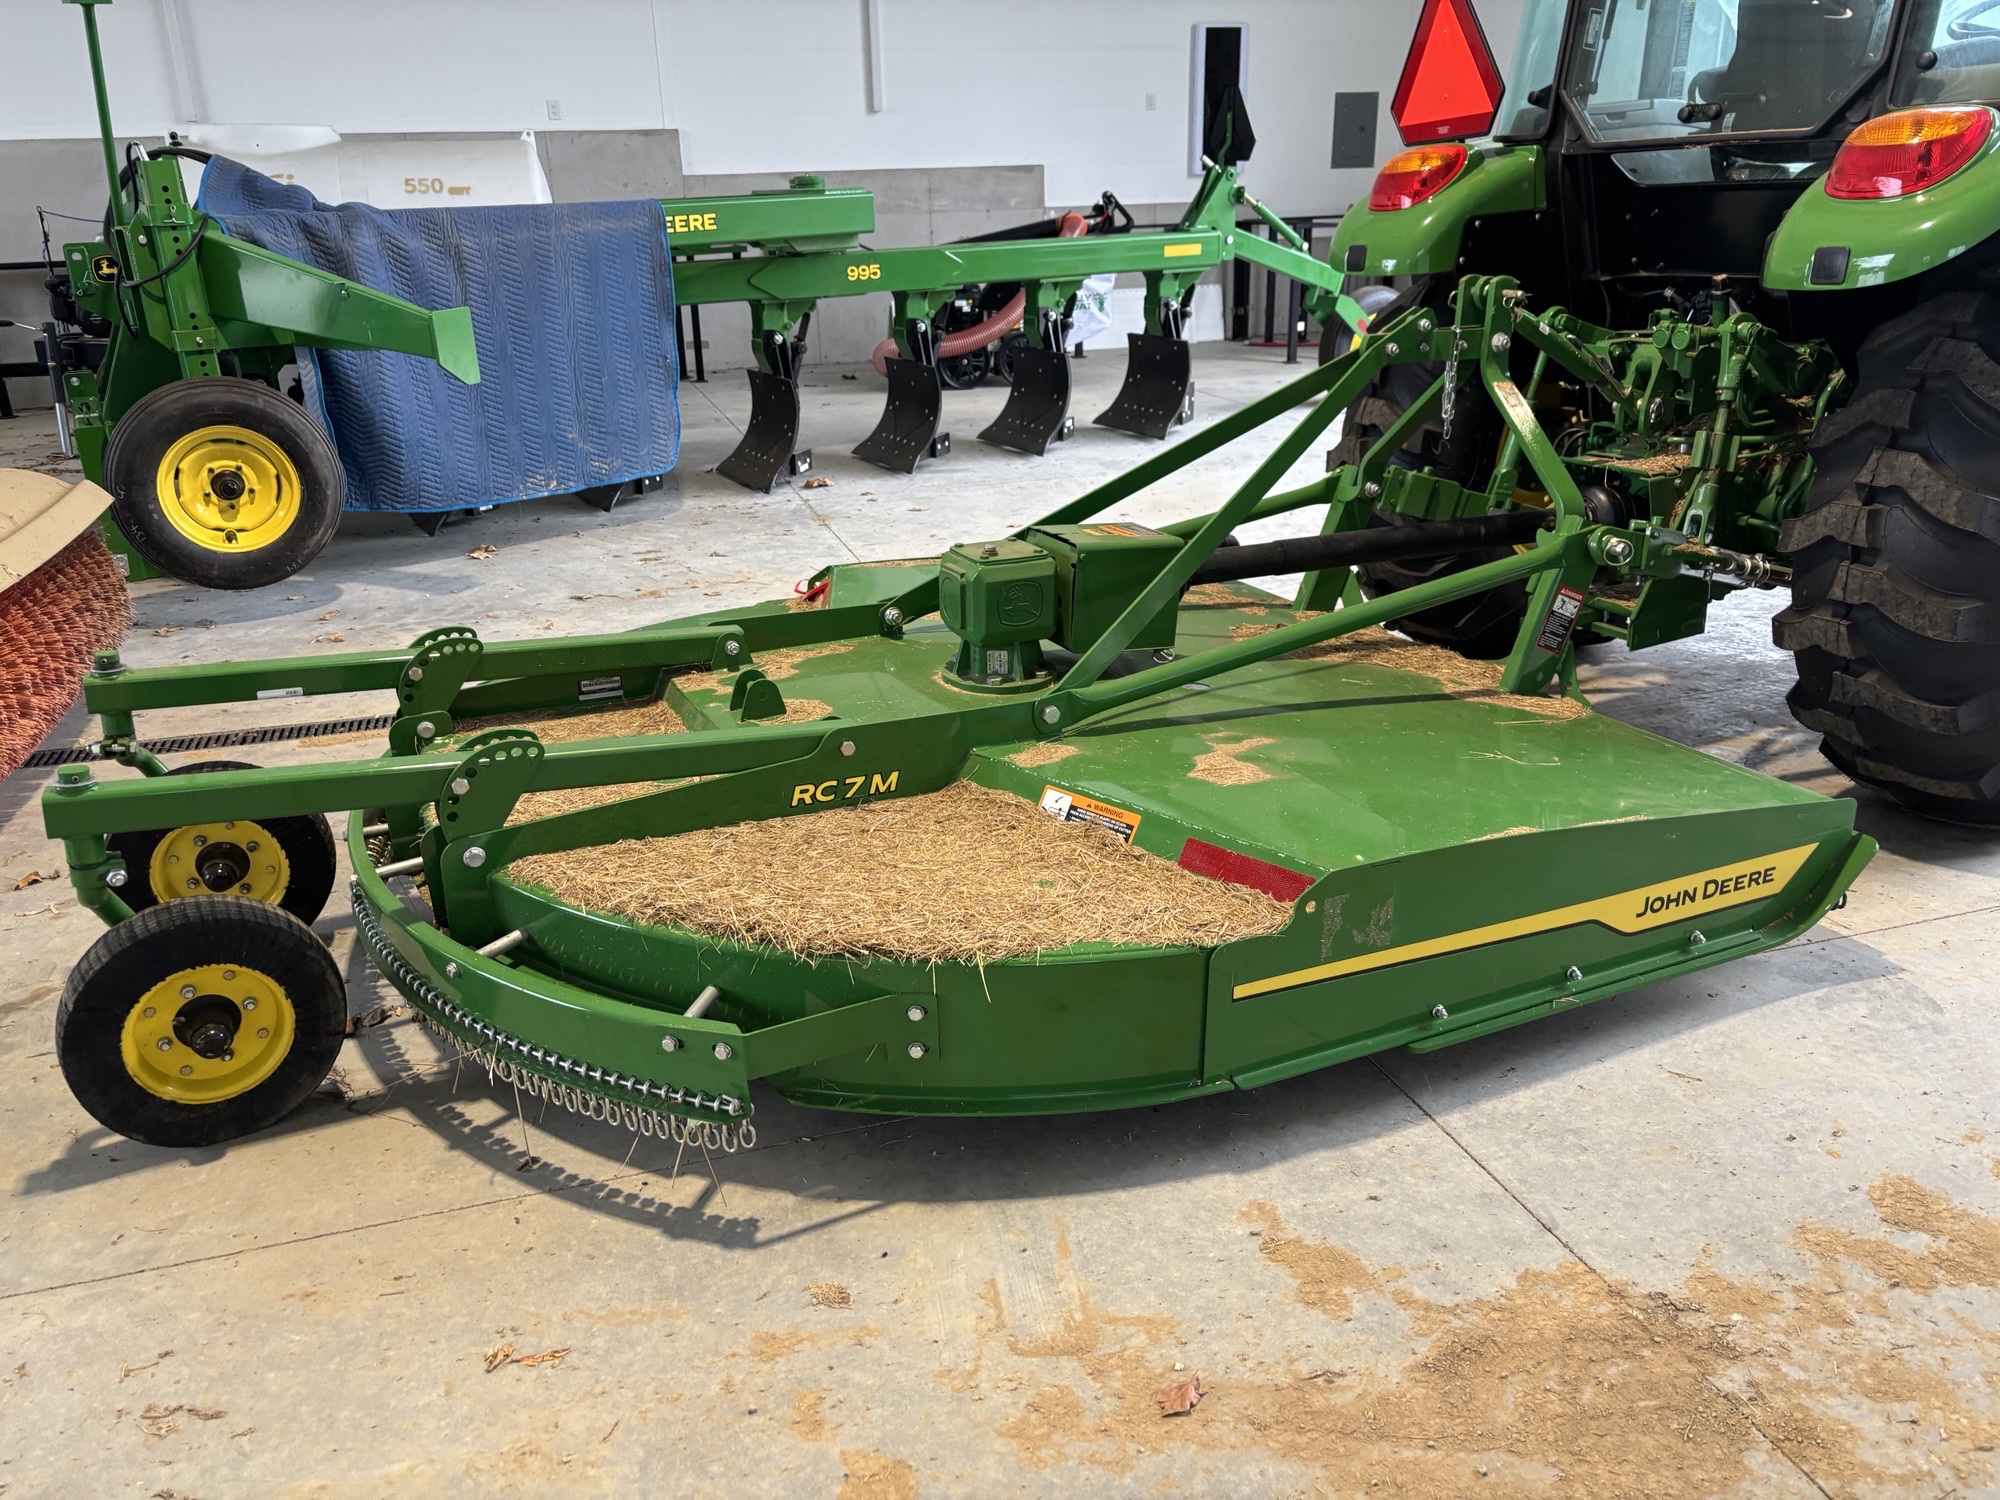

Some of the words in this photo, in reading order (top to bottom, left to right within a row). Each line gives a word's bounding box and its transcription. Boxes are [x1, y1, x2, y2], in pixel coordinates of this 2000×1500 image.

[404, 177, 444, 194] 550
[665, 212, 718, 233] EERE
[847, 264, 881, 281] 995
[1094, 803, 1124, 819] WARNING
[1635, 887, 1698, 918] JOHN
[1702, 866, 1777, 900] DEERE
